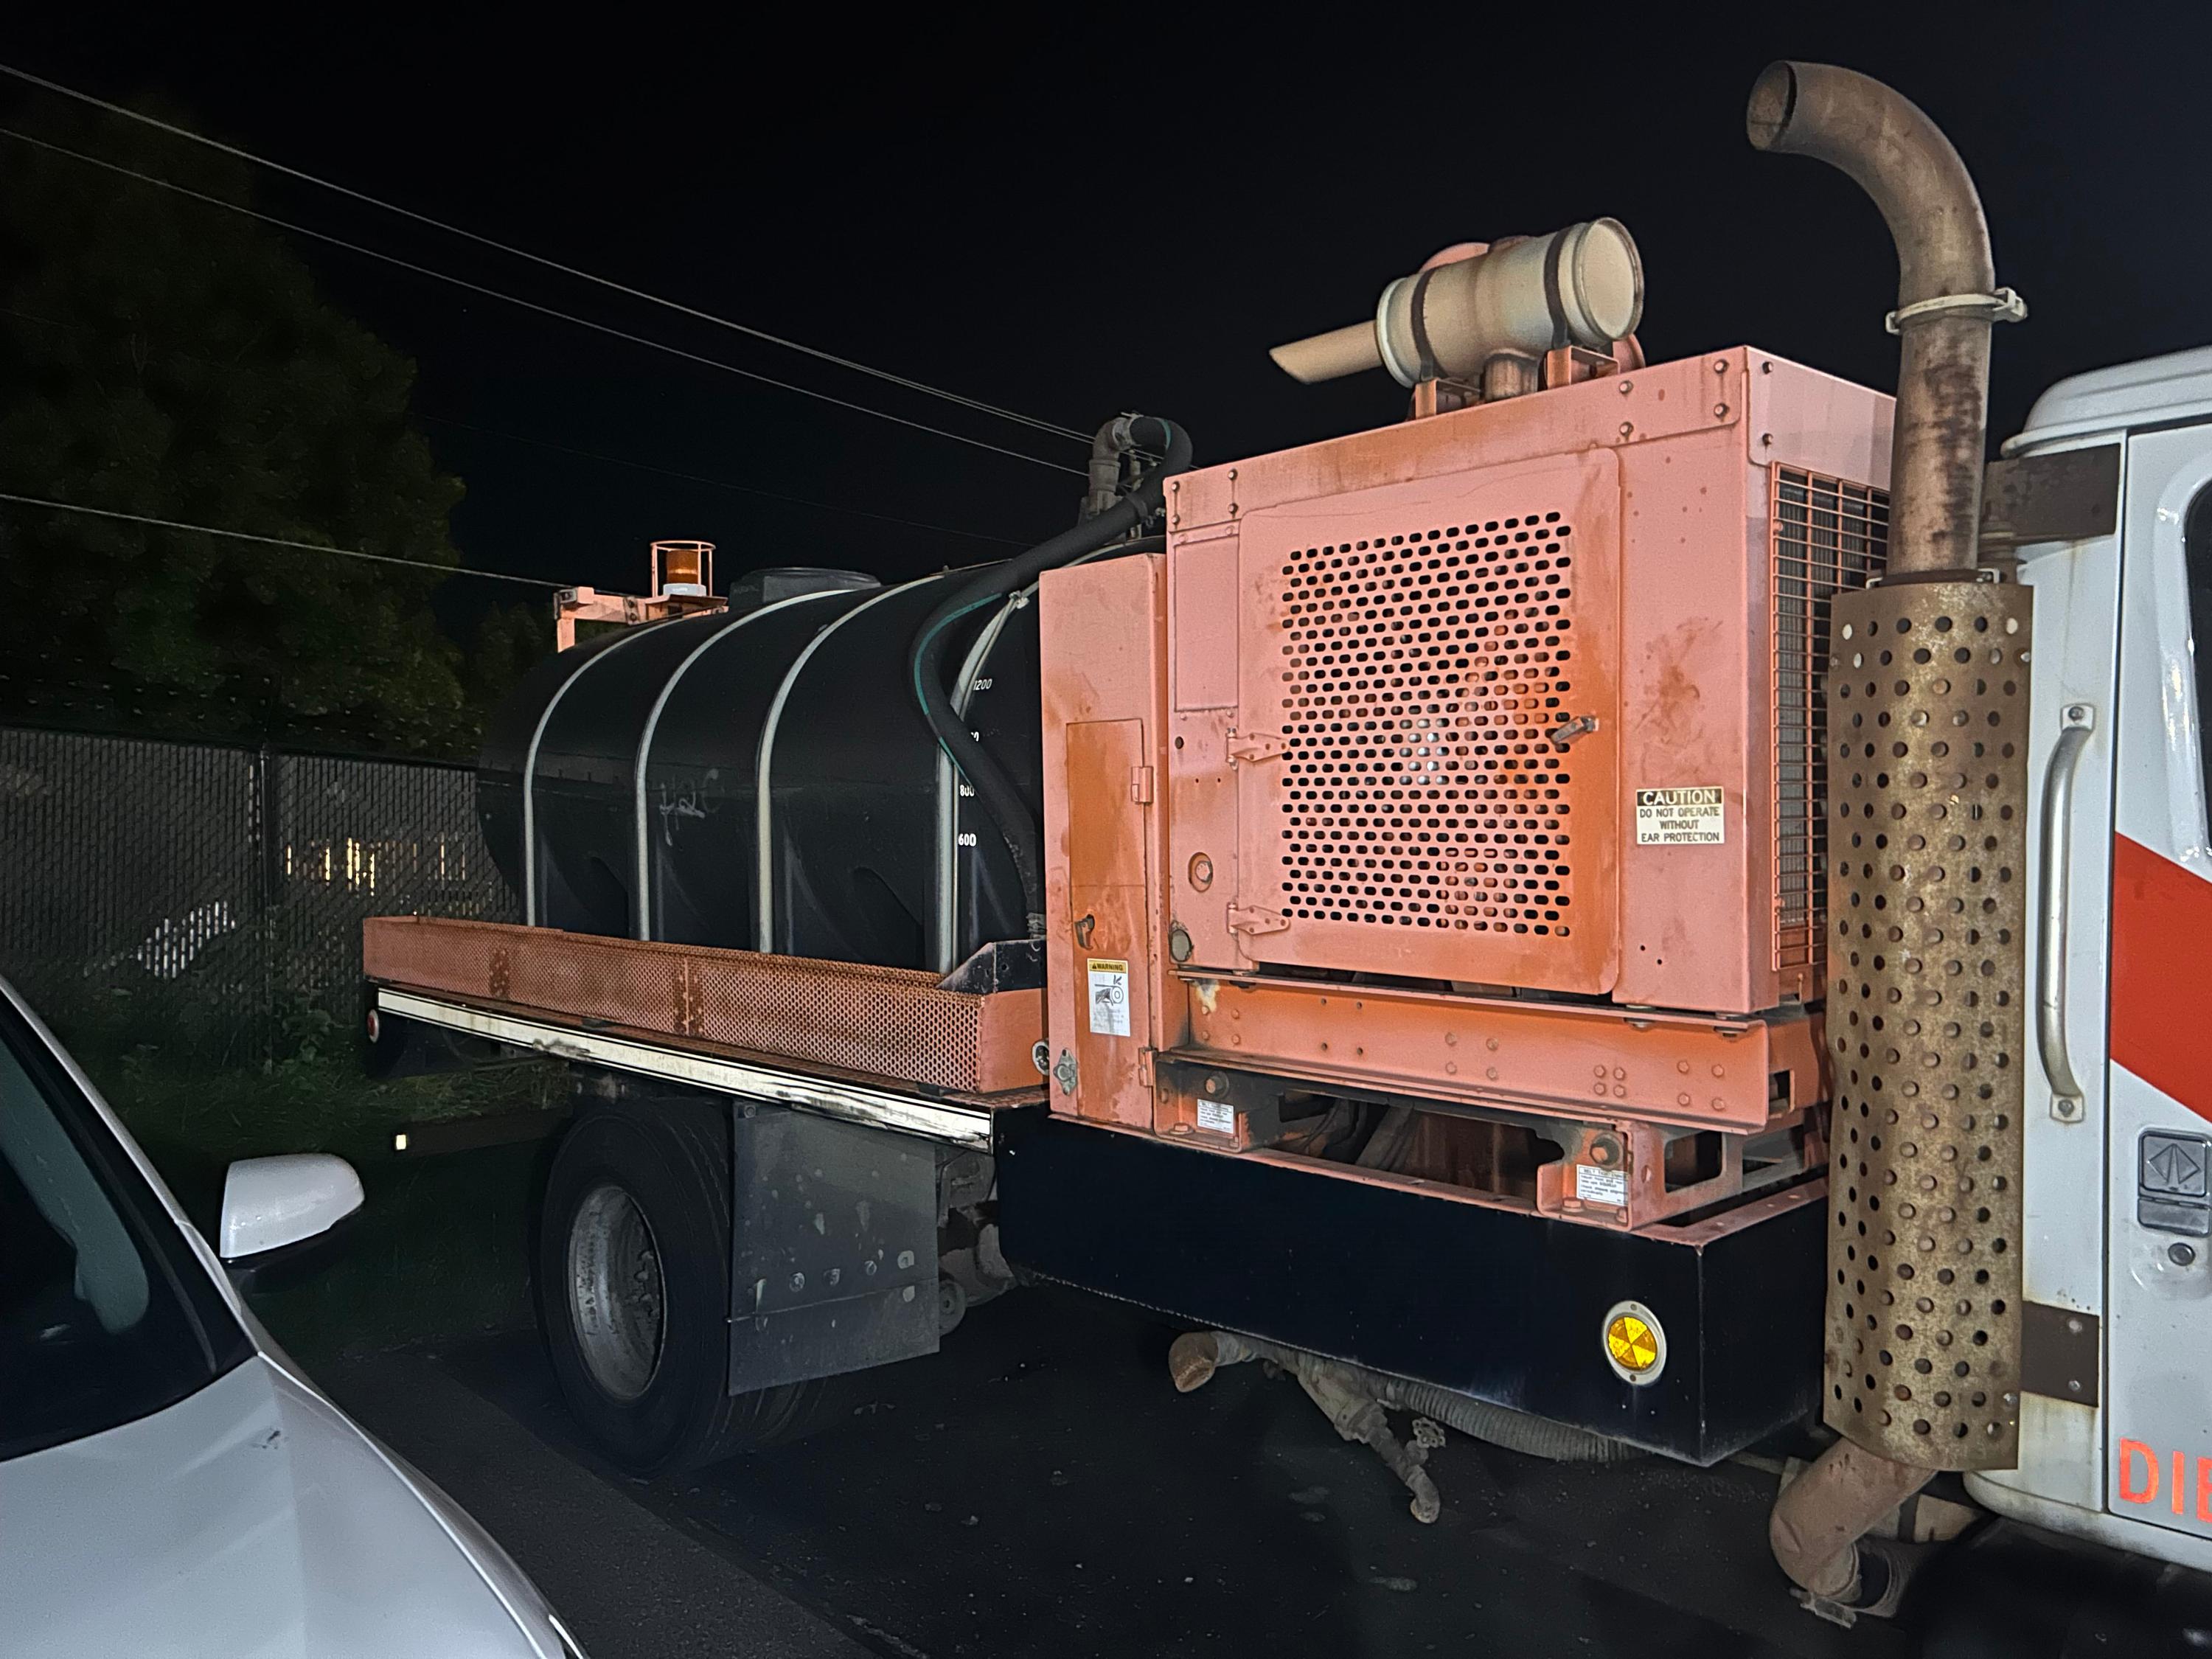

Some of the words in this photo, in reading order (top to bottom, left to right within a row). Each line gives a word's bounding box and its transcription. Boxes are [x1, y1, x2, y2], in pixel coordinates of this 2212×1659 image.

[973, 678, 992, 692] 1200
[960, 785, 975, 797] 800
[1643, 790, 1716, 806] CAUTION
[1640, 808, 1652, 818] DO
[1656, 807, 1674, 818] NOT
[1678, 806, 1719, 817] OPERATE
[1659, 819, 1700, 830] WITHOUT
[959, 833, 977, 846] 600
[1641, 832, 1660, 842] EAR
[1663, 832, 1719, 842] PROTECTION
[1096, 963, 1124, 971] WARNING
